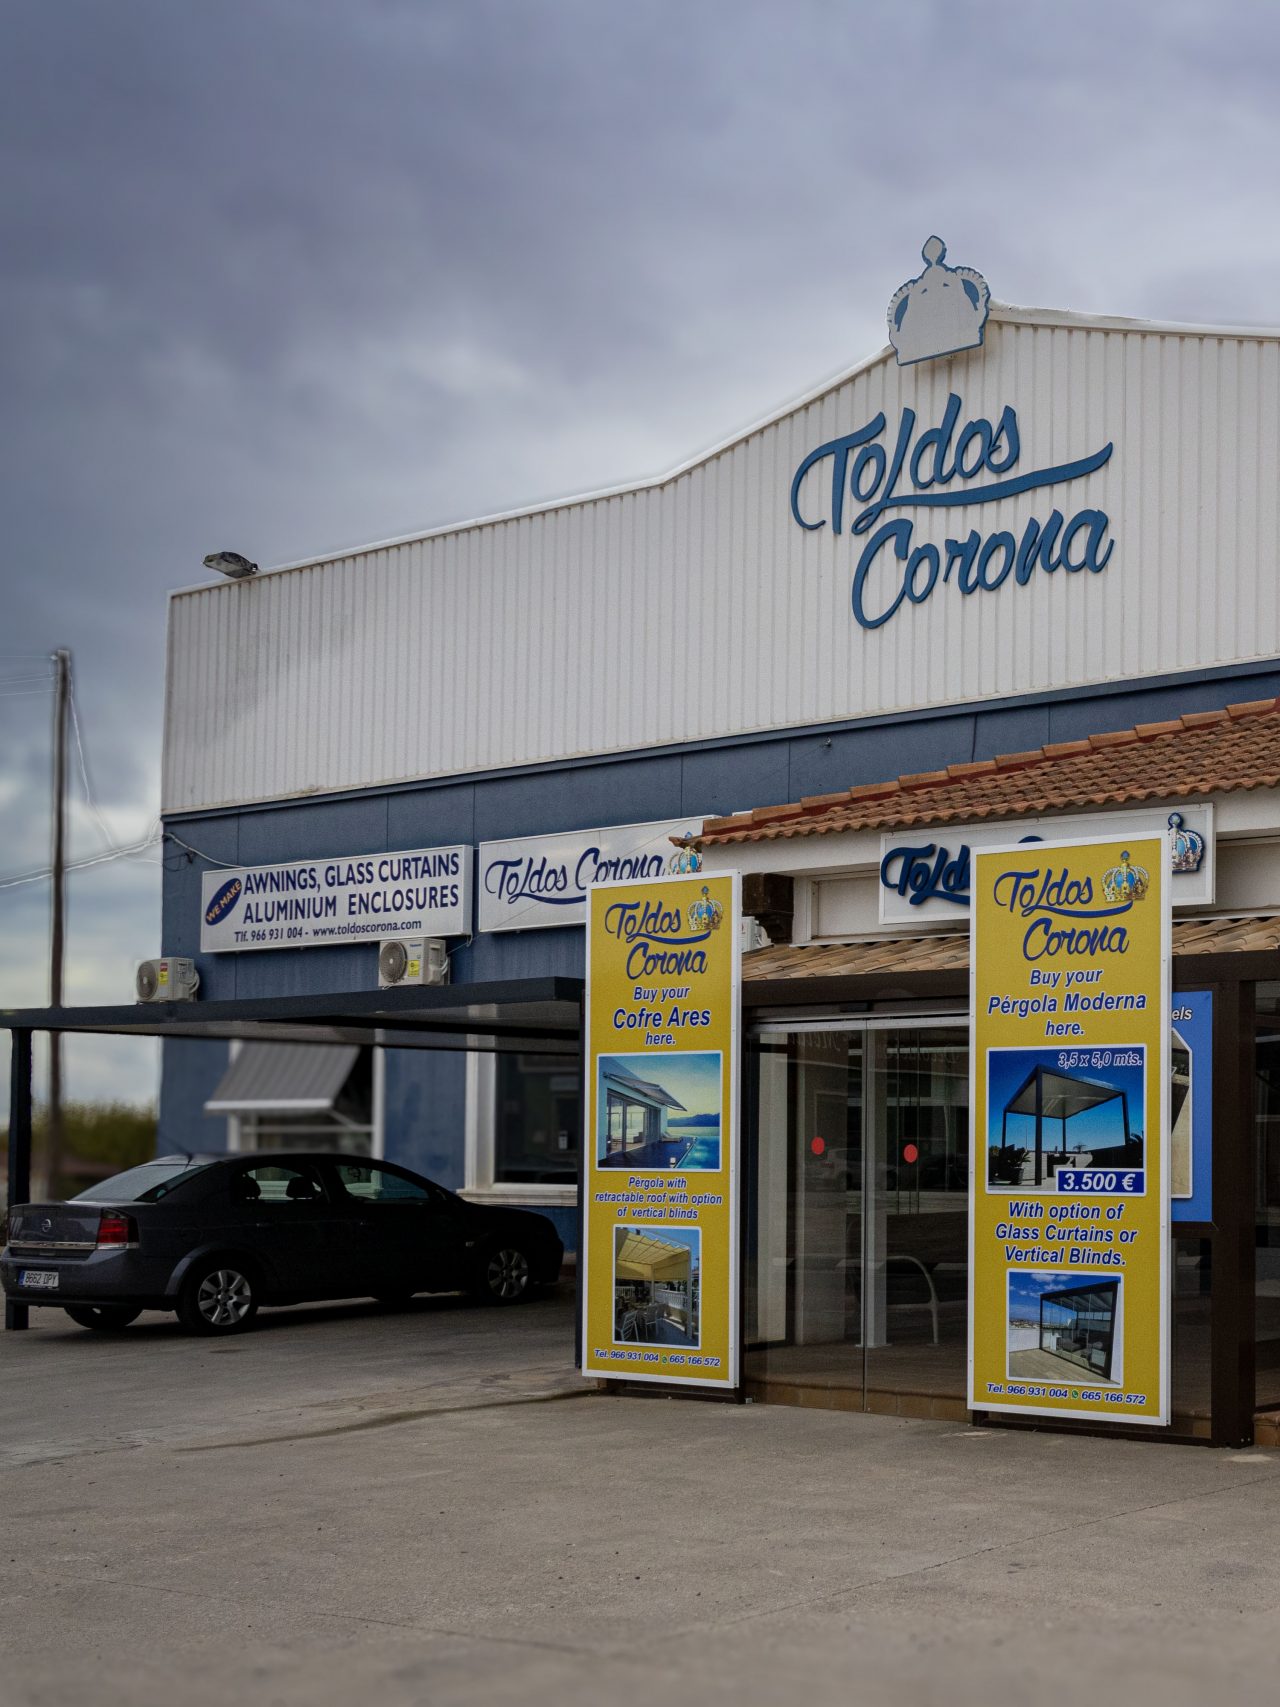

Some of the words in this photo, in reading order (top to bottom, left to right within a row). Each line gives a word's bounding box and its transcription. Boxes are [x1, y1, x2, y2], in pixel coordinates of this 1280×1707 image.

[791, 392, 1113, 535] Toldos
[852, 509, 1115, 629] Corona
[244, 867, 321, 895] AWNINGS,
[325, 861, 374, 887] GLASS
[378, 852, 460, 881] CURTAINS
[484, 856, 587, 905] Toldos
[881, 843, 970, 905] Told
[243, 895, 337, 924] ALUMINIUM
[348, 884, 460, 916] ENCLOSURES
[993, 868, 1133, 919] Toldos
[234, 931, 249, 943] Tlf.
[251, 929, 267, 941] 966
[268, 928, 284, 940] 931
[287, 926, 303, 939] 004
[312, 919, 422, 937] www.toldoscorona.com
[605, 901, 712, 945] Toldos
[1022, 917, 1130, 962] Corona
[626, 942, 708, 980] Corona
[1029, 968, 1061, 988] Buy
[1065, 967, 1104, 988] your
[633, 986, 658, 1003] Buy
[661, 987, 690, 1003] your
[987, 995, 1058, 1019] Pérgola
[1063, 991, 1147, 1013] Moderna
[613, 1007, 662, 1029] Cofre
[667, 1006, 711, 1028] Ares
[1172, 1006, 1192, 1020] els
[645, 1032, 676, 1046] here.
[1044, 1021, 1085, 1037] here.
[1058, 1052, 1078, 1069] 3,5
[1079, 1055, 1089, 1067] x
[1091, 1051, 1111, 1069] 5,0
[1113, 1051, 1143, 1066] mts.
[667, 1177, 687, 1189] with
[1063, 1173, 1117, 1191] 3.500
[1121, 1173, 1136, 1191] €
[595, 1192, 645, 1203] retractable
[646, 1192, 667, 1203] roof
[668, 1193, 689, 1205] with
[691, 1193, 722, 1207] option
[617, 1206, 628, 1217] of
[631, 1207, 666, 1218] vertical
[668, 1207, 699, 1220] blinds
[1009, 1201, 1044, 1218] With
[1049, 1203, 1101, 1222] option
[1106, 1204, 1125, 1220] of
[995, 1223, 1040, 1240] Glass
[1045, 1225, 1114, 1243] Curtains
[1119, 1229, 1138, 1243] or
[1004, 1245, 1064, 1264] Vertical
[1068, 1248, 1126, 1266] Blinds.
[594, 1349, 609, 1358] Tel.
[610, 1350, 626, 1360] 966
[627, 1351, 642, 1361] 931
[643, 1352, 659, 1362] 004
[669, 1355, 685, 1365] 665
[687, 1356, 702, 1366] 166
[703, 1357, 720, 1367] 572
[987, 1383, 1005, 1394] Tel.
[1007, 1385, 1026, 1396] 966
[1028, 1386, 1046, 1397] 931
[1049, 1387, 1068, 1399] 004
[1081, 1390, 1101, 1401] 665
[1104, 1392, 1123, 1403] 166
[1125, 1394, 1146, 1405] 572
